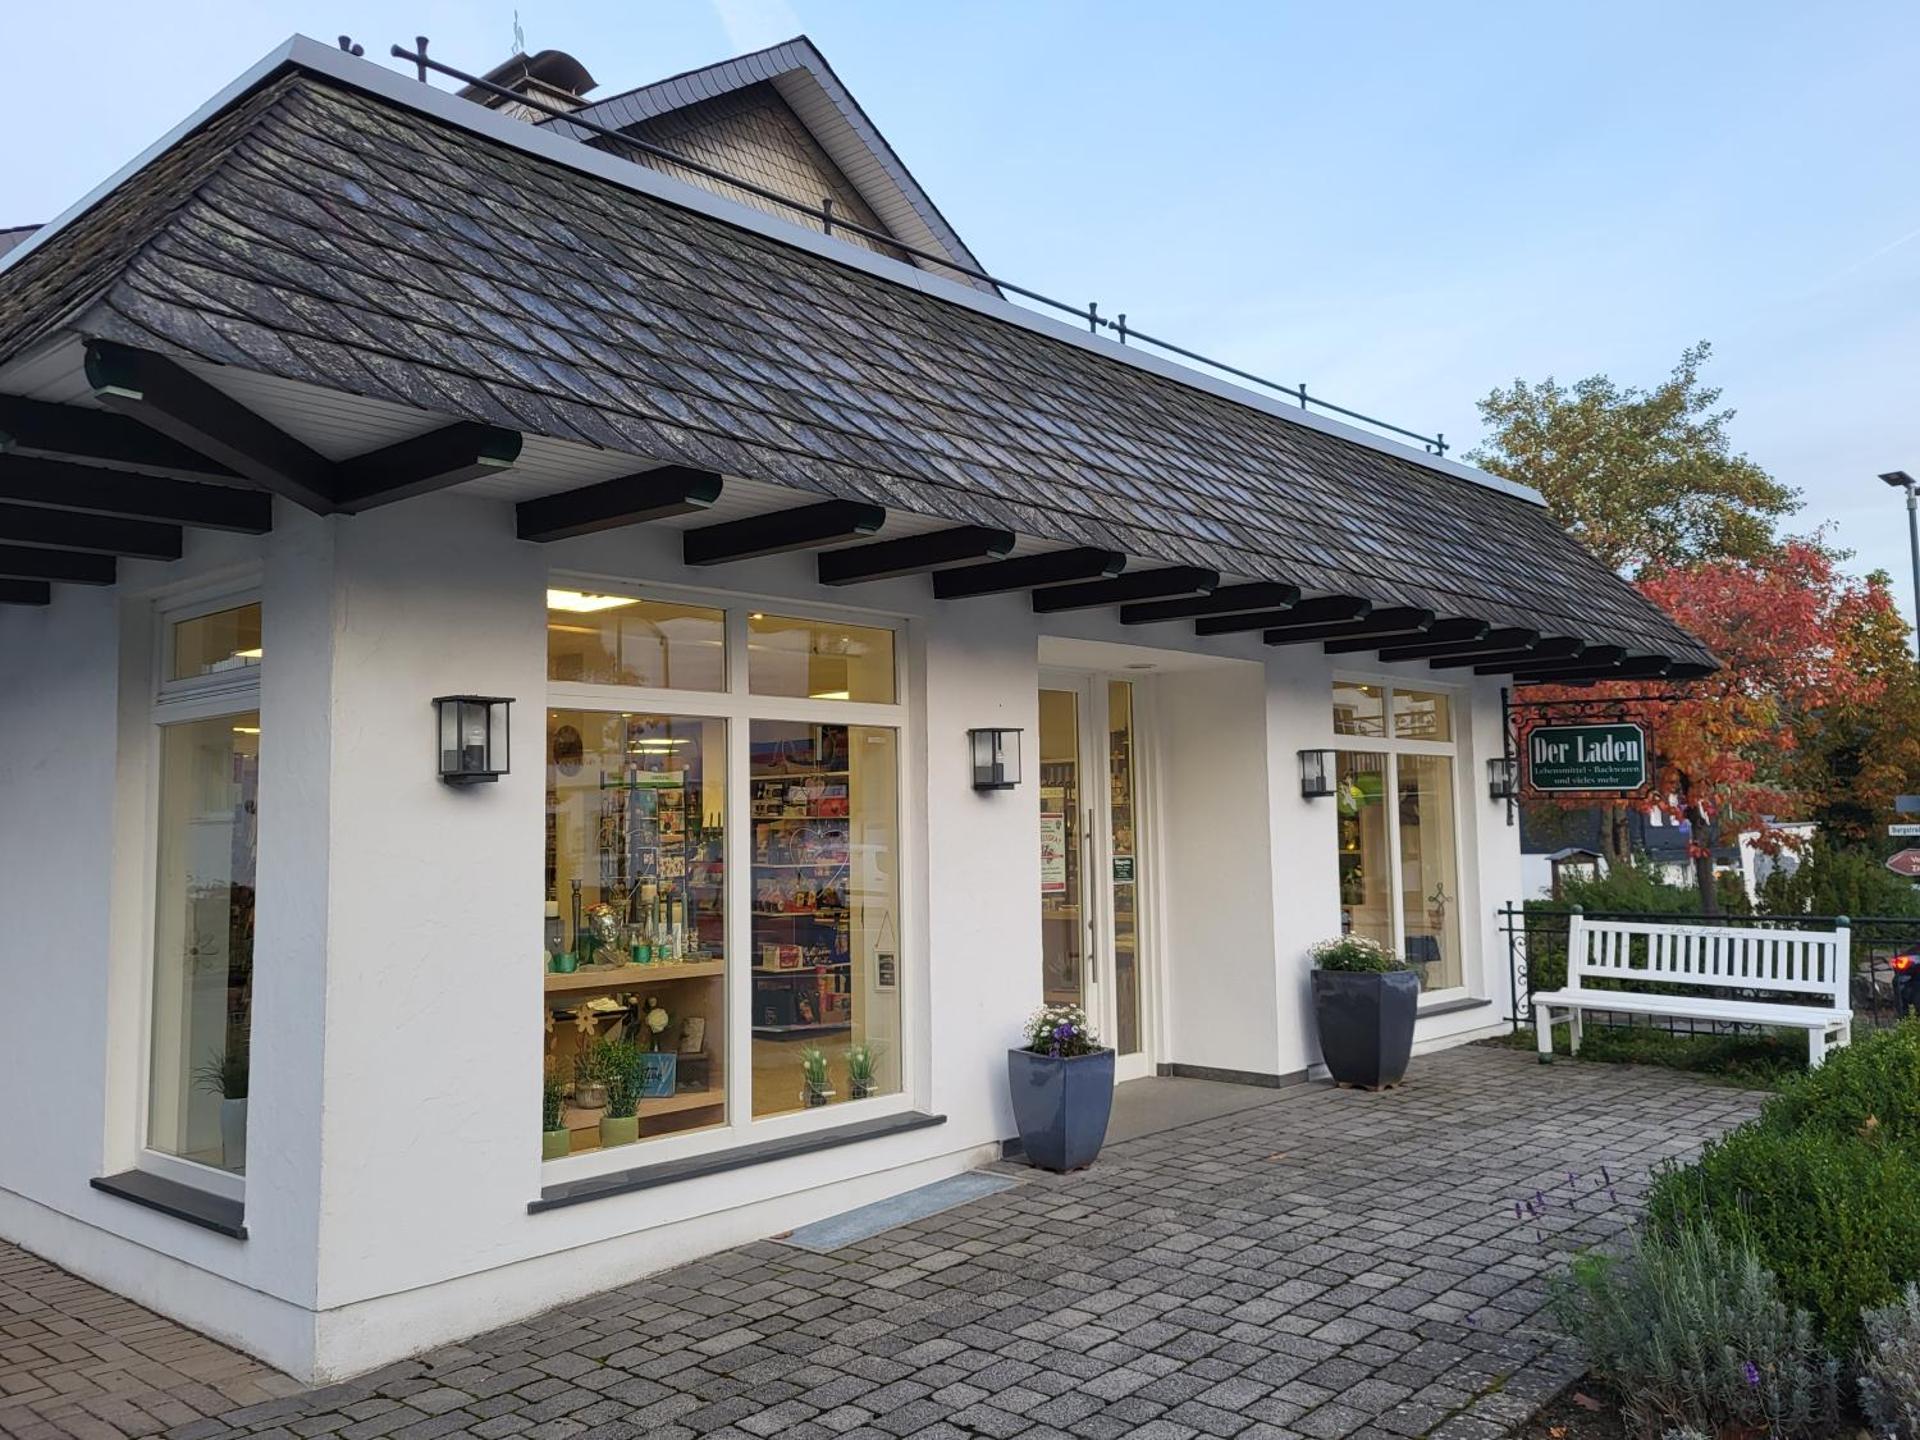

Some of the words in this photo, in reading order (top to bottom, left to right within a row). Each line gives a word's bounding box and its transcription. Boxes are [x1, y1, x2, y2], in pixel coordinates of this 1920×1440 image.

[1534, 736, 1570, 764] Der
[1577, 734, 1639, 763] Laden
[1554, 777, 1570, 785] und
[1572, 776, 1596, 784] vieles
[1598, 776, 1619, 784] mehr
